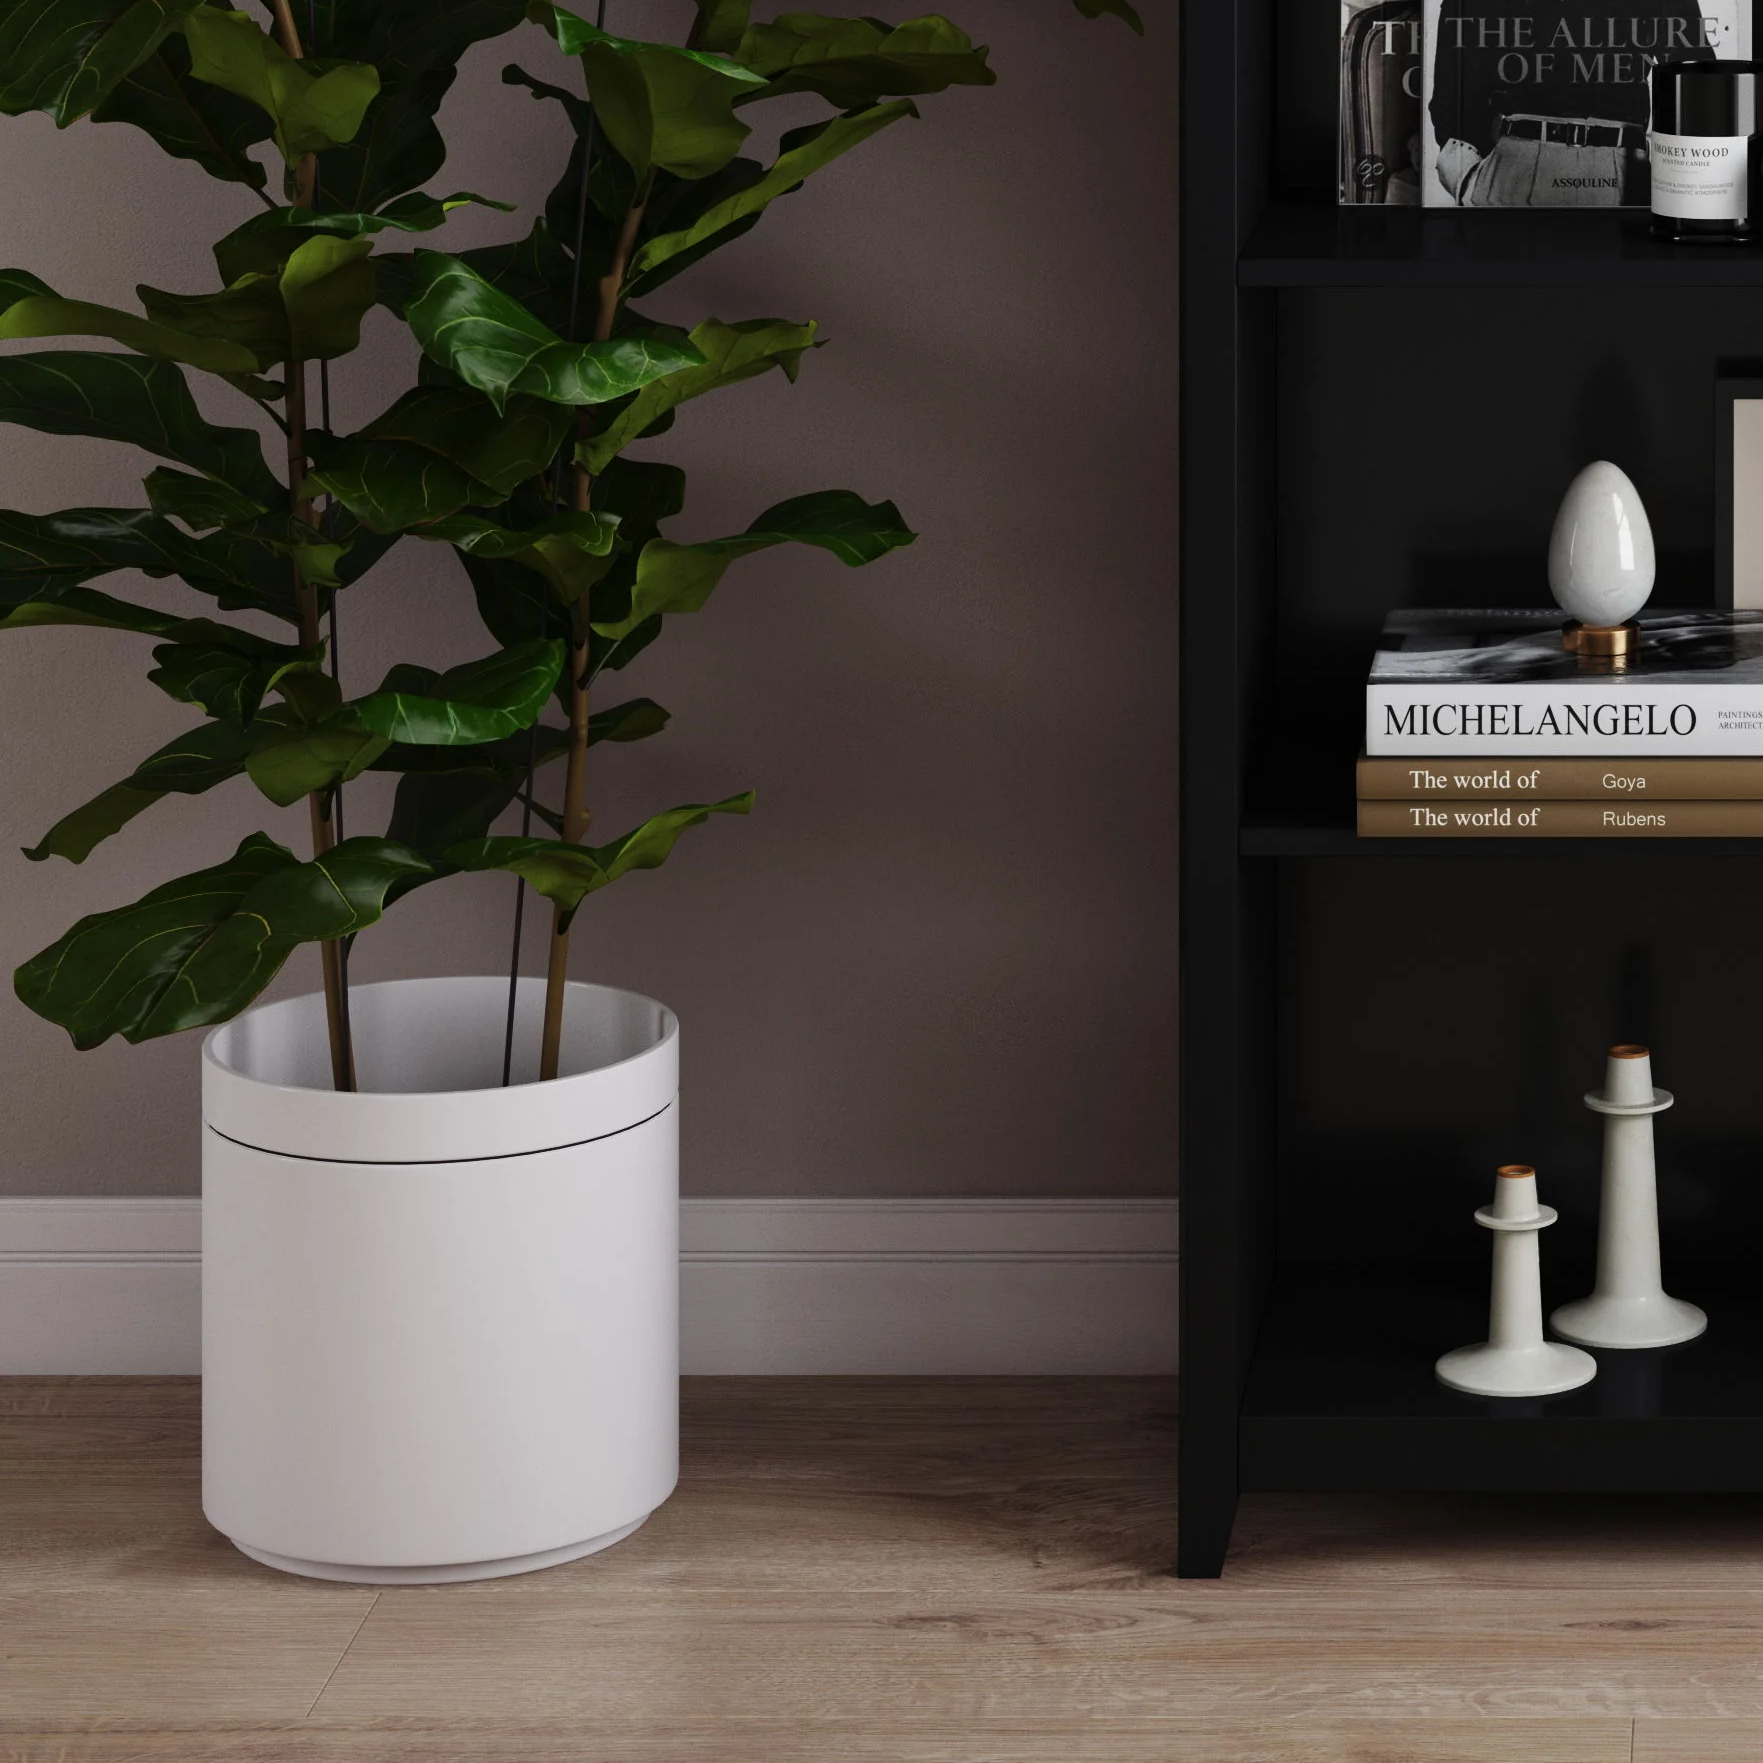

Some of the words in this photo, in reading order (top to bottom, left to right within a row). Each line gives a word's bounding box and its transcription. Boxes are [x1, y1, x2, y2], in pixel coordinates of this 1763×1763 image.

[1444, 16, 1537, 49] THE
[1549, 16, 1721, 49] ALLURE
[1497, 52, 1556, 84] OF
[1690, 147, 1729, 158] WOOD
[1551, 178, 1618, 188] ASSOULINE
[1383, 703, 1697, 736] MICHELANGELO
[1408, 769, 1448, 789] The
[1453, 769, 1512, 789] world
[1516, 769, 1541, 789] of
[1602, 773, 1646, 792] Goya
[1409, 807, 1448, 827] The
[1453, 807, 1512, 827] world
[1517, 807, 1541, 827] of
[1603, 811, 1666, 827] Rubens
